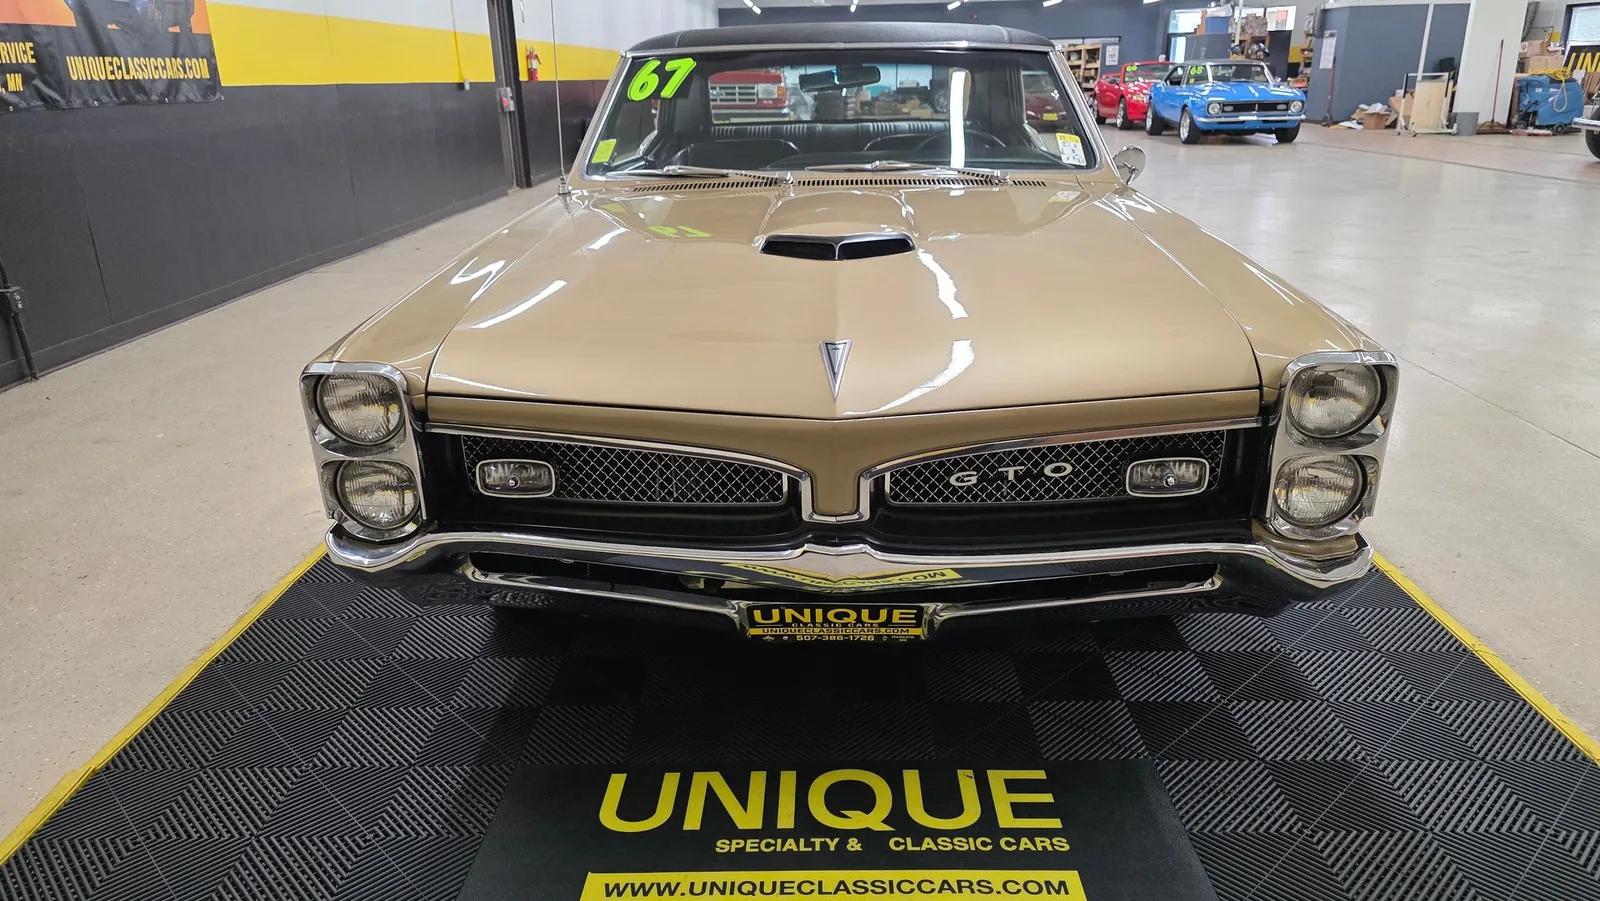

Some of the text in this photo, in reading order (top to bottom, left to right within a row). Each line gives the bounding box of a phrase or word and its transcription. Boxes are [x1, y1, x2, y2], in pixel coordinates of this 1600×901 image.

[0, 42, 36, 63] RVICE
[66, 56, 209, 81] UNIQUECLASSICCARS.COM
[6, 73, 23, 92] MN
[627, 57, 696, 102] 67
[949, 462, 1073, 487] GTO
[753, 608, 917, 624] UNIQUE
[599, 769, 1062, 832] UNIQUE
[715, 837, 1070, 852] SPECIALTY & CLASSIC CARS
[604, 879, 1070, 898] WWW.UNIQUECLASSICCARS.COM
